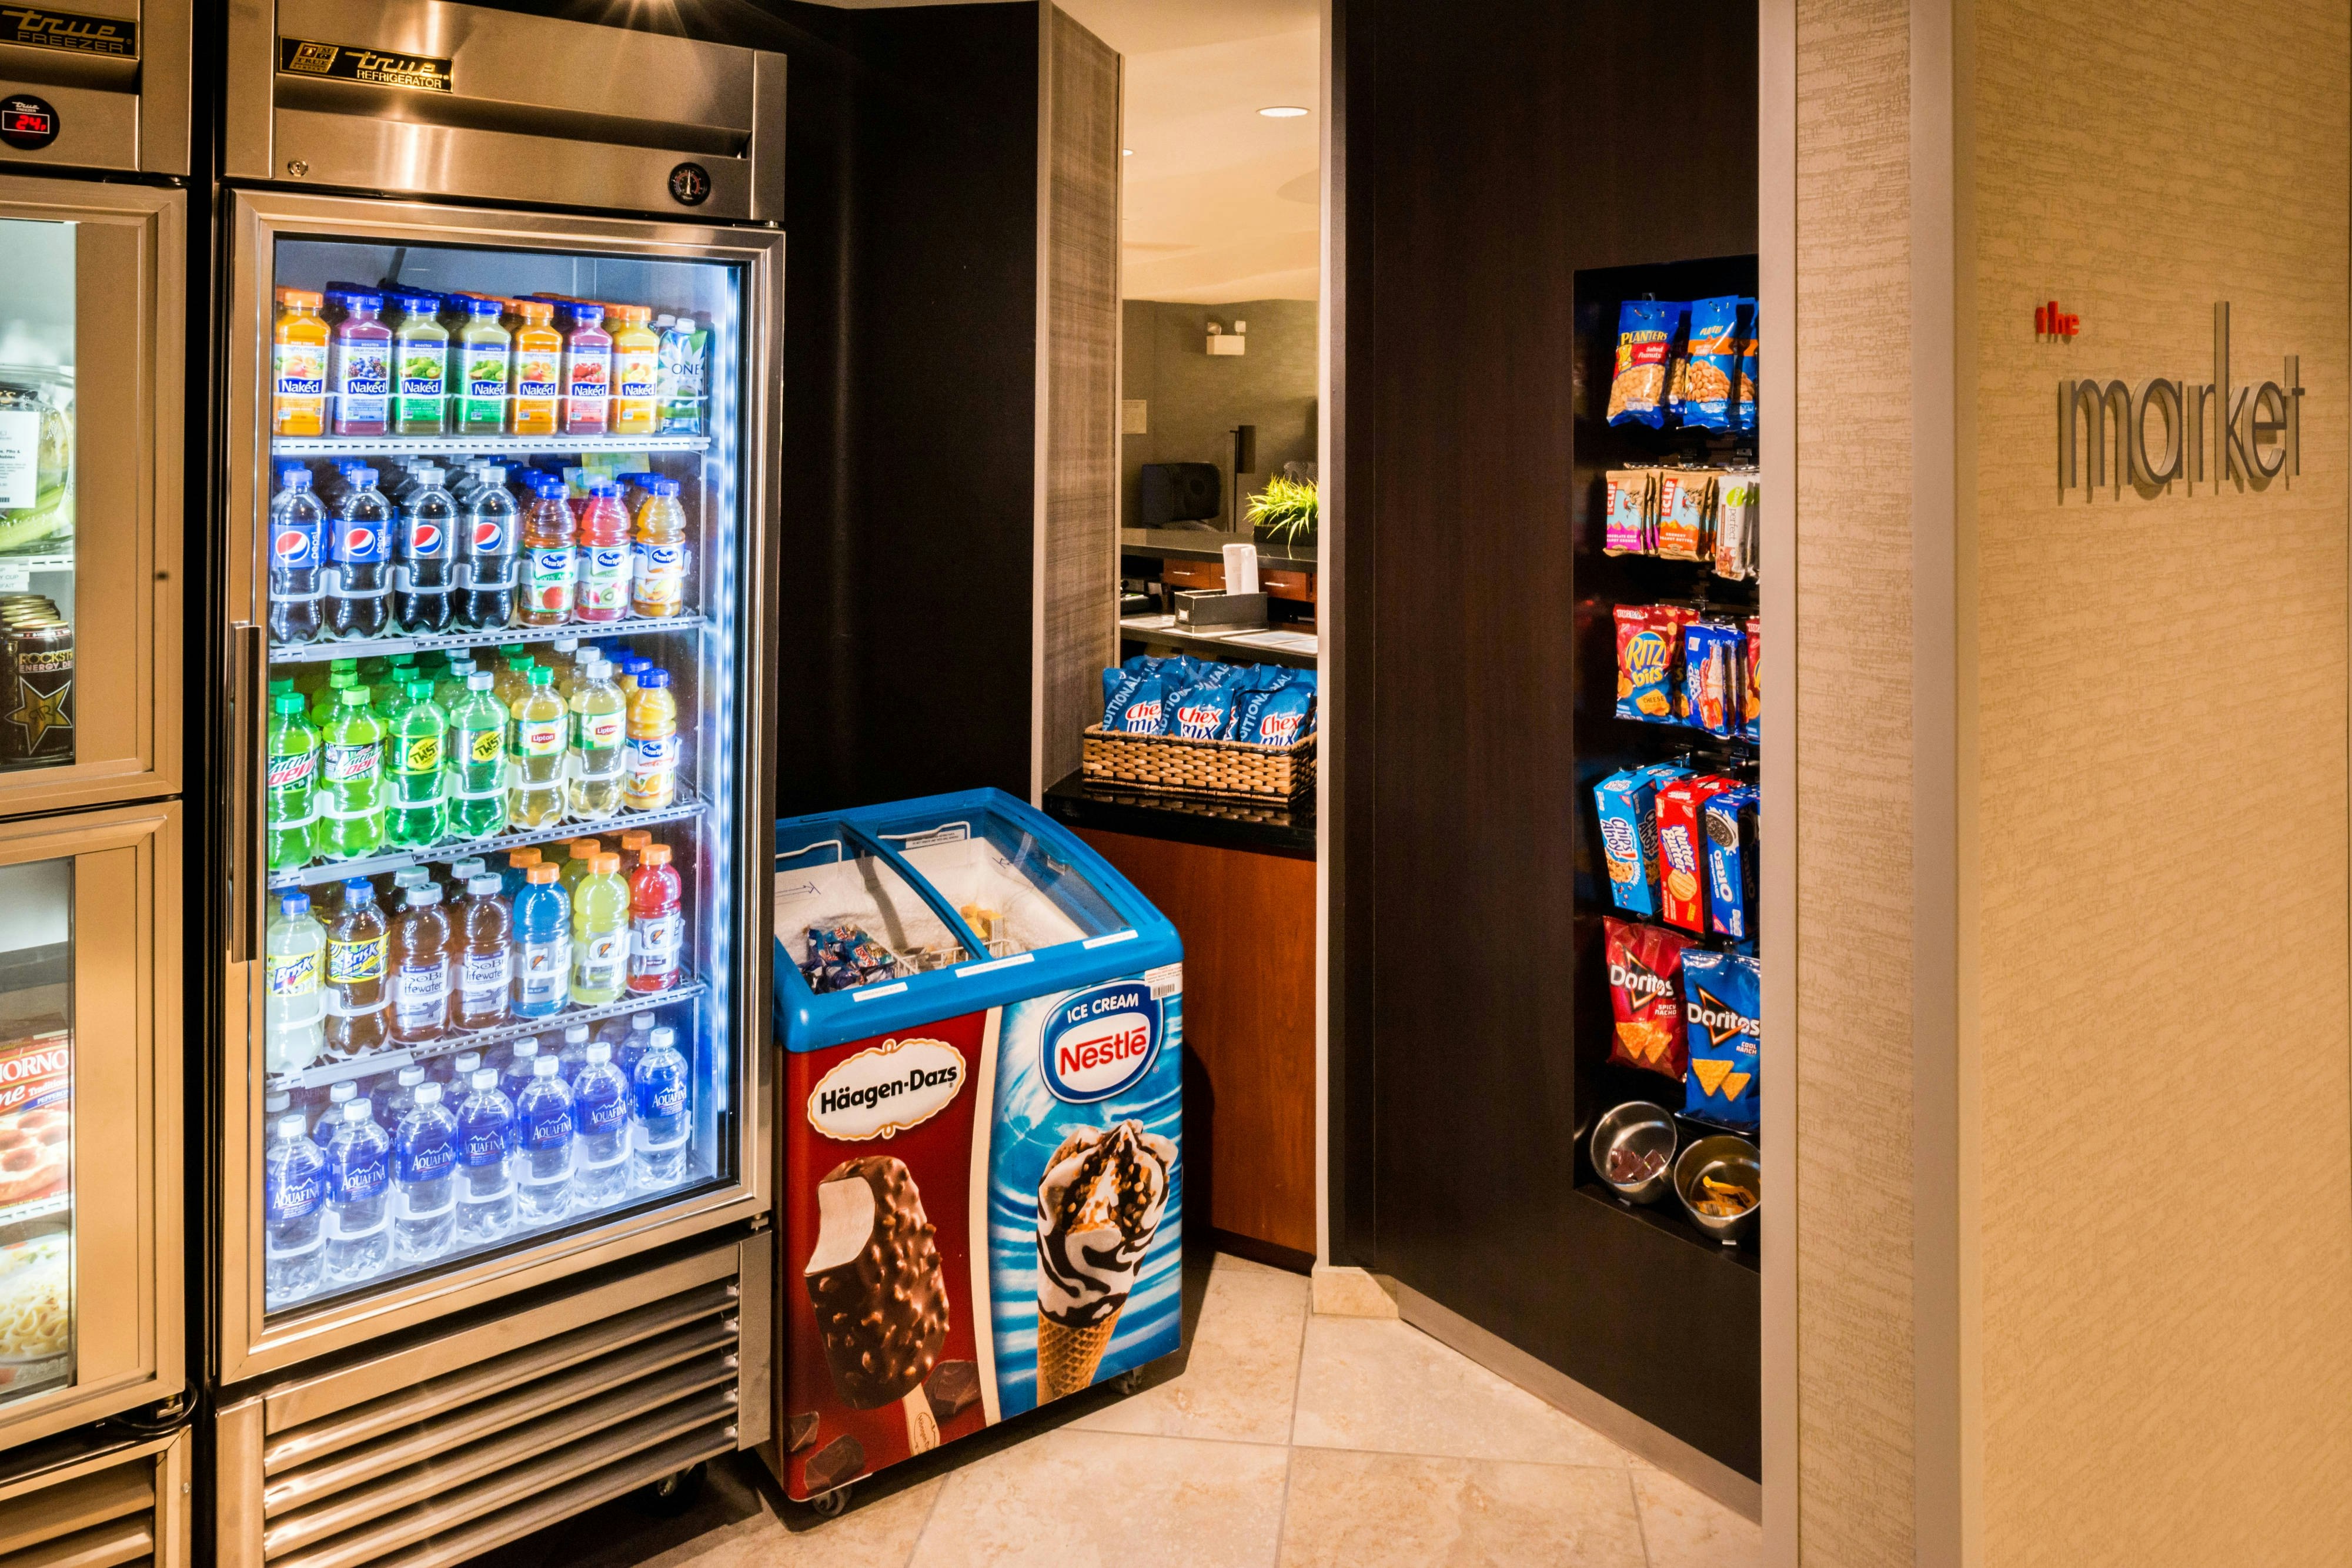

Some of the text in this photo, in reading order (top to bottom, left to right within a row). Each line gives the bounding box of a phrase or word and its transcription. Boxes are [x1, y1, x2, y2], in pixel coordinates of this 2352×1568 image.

[2, 10, 125, 42] true
[18, 31, 123, 54] FREEZER
[345, 51, 442, 79] true
[357, 69, 442, 89] REFRIGERATOR
[2036, 301, 2080, 335] the
[1621, 330, 1668, 345] PLANTERS
[672, 363, 700, 375] ONE
[282, 381, 319, 393] Naked
[351, 382, 386, 393] Naked
[405, 382, 439, 393] Naked
[475, 384, 506, 395] Naked
[523, 385, 554, 396] Naked
[574, 385, 604, 396] Naked
[626, 385, 654, 395] Naked
[2059, 301, 2306, 488] market
[1608, 484, 1616, 507] CLIF
[1662, 480, 1675, 507] CLIF
[1729, 509, 1738, 541] perfect
[1626, 637, 1666, 670] RITZ
[19, 663, 59, 673] ENERGY
[1632, 666, 1663, 687] bits
[1127, 703, 1161, 720] Che
[1179, 707, 1223, 724] Chex
[1182, 724, 1217, 740] mix
[1261, 713, 1304, 735] Chex
[1612, 818, 1633, 851] Chips
[1661, 828, 1687, 874] Butter
[1672, 825, 1696, 871] Nutter
[1713, 850, 1734, 903] OREO
[405, 981, 442, 994] ifewater
[1610, 965, 1674, 997] Doritos
[1067, 993, 1139, 1024] ICE CREAM
[1688, 1002, 1760, 1036] Doritos
[1060, 1025, 1147, 1076] Nestlé
[1736, 1046, 1758, 1055] RANCH
[1741, 1041, 1756, 1050] COOL
[652, 1086, 687, 1108] AQUAFINA
[821, 1065, 957, 1114] Häagen-Dazs
[590, 1101, 627, 1125] AQUAFINA
[533, 1116, 572, 1141] AQUAFINA
[464, 1135, 505, 1155] AQUAFINA
[412, 1147, 453, 1172] AQUAFINA
[341, 1165, 386, 1192] AQUAFINA
[273, 1185, 320, 1209] AQUAFINA
